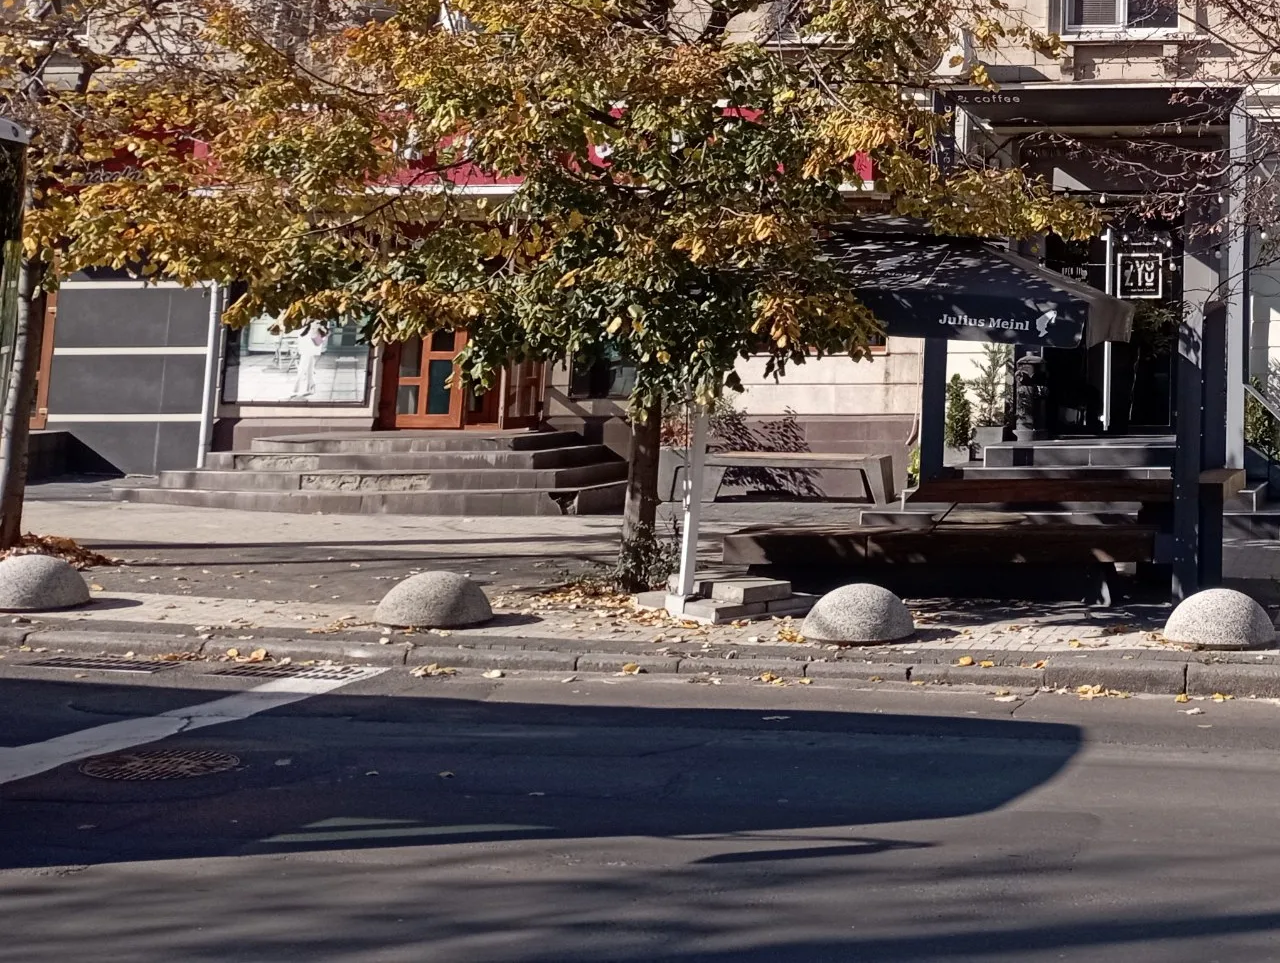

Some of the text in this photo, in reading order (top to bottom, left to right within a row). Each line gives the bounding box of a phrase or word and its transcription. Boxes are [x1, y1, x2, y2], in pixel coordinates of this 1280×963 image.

[974, 94, 1020, 103] coffee
[939, 313, 1030, 331] Julius Meinl
